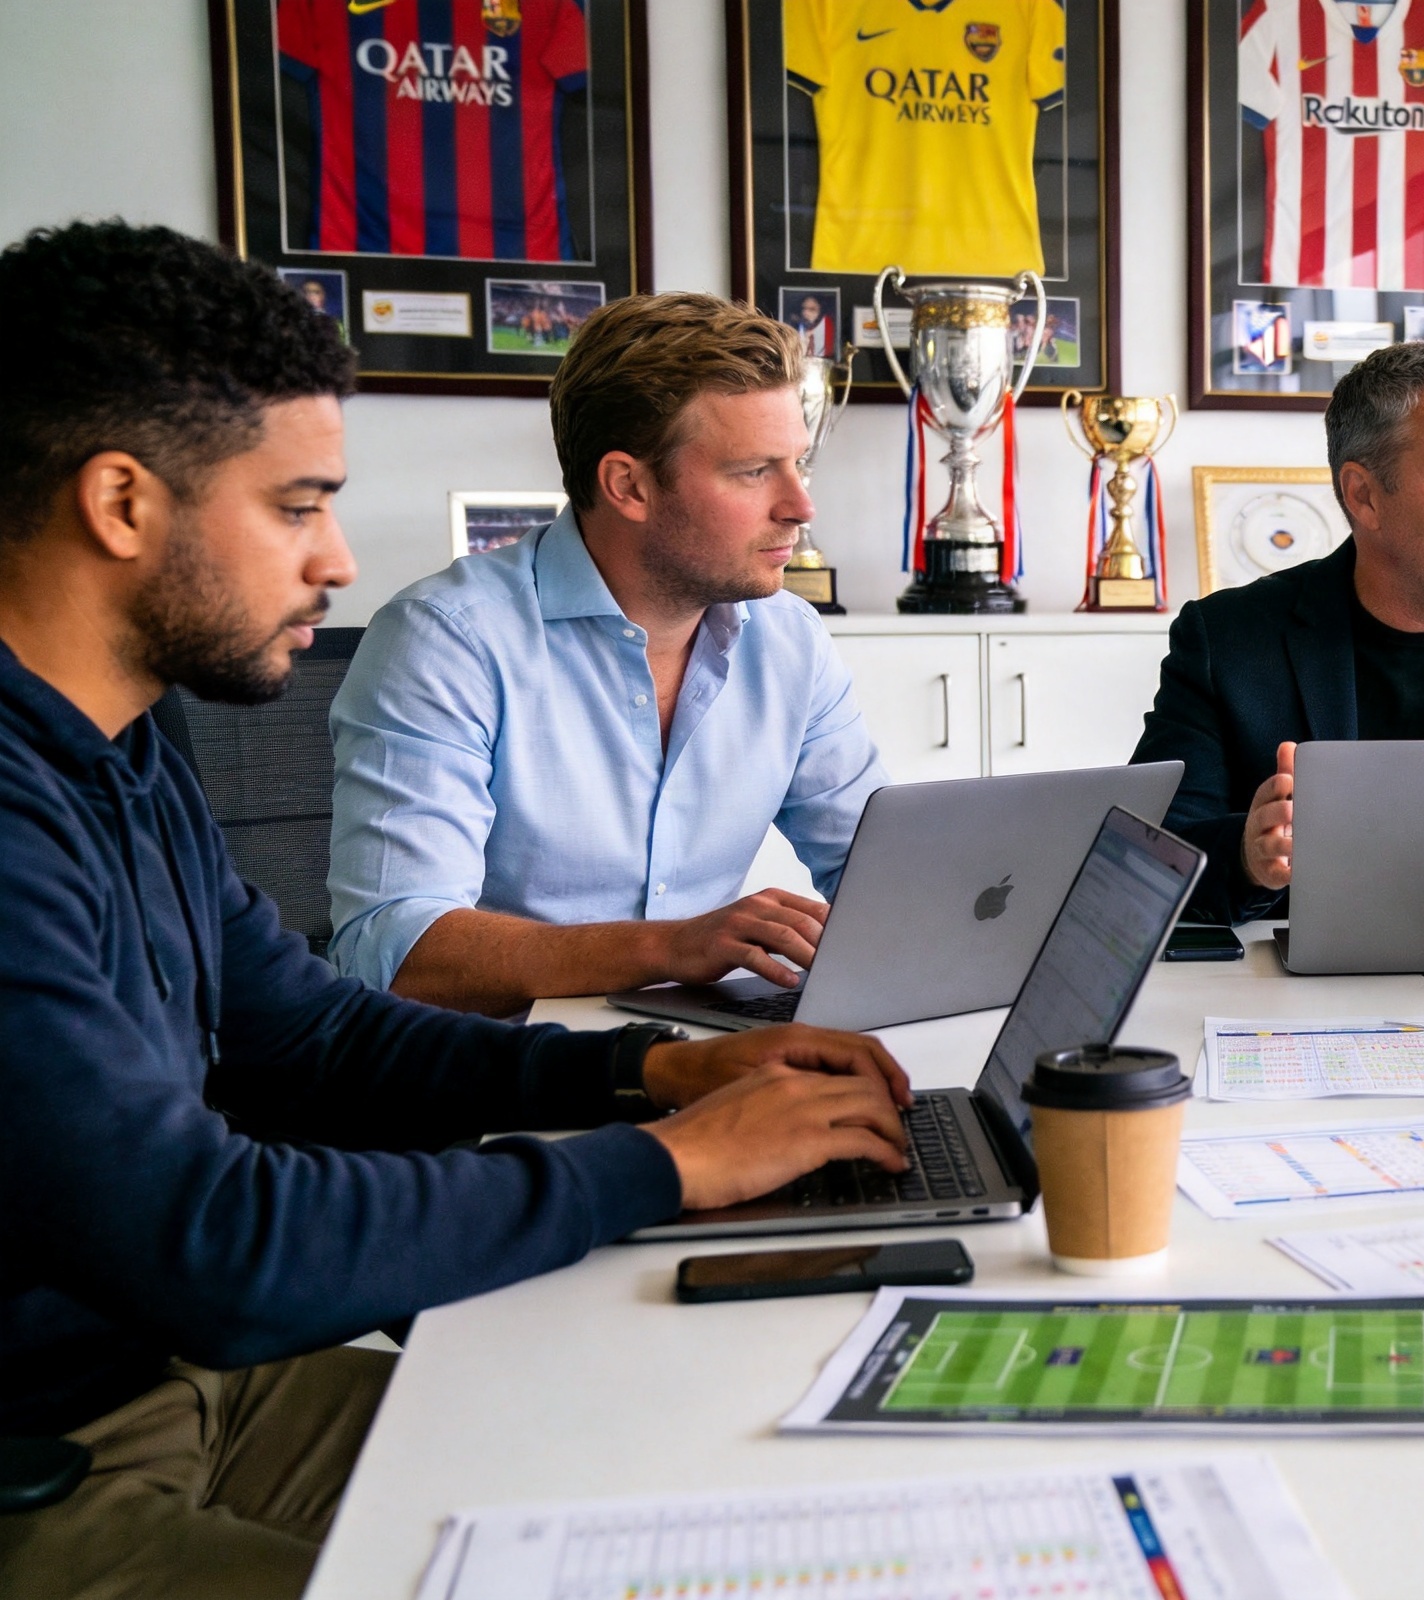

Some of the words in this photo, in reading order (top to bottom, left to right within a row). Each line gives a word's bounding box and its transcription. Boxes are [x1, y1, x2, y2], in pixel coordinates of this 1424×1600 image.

[356, 38, 511, 83] QATAR
[396, 76, 513, 107] AIRWAYS
[865, 67, 990, 105] QATAR
